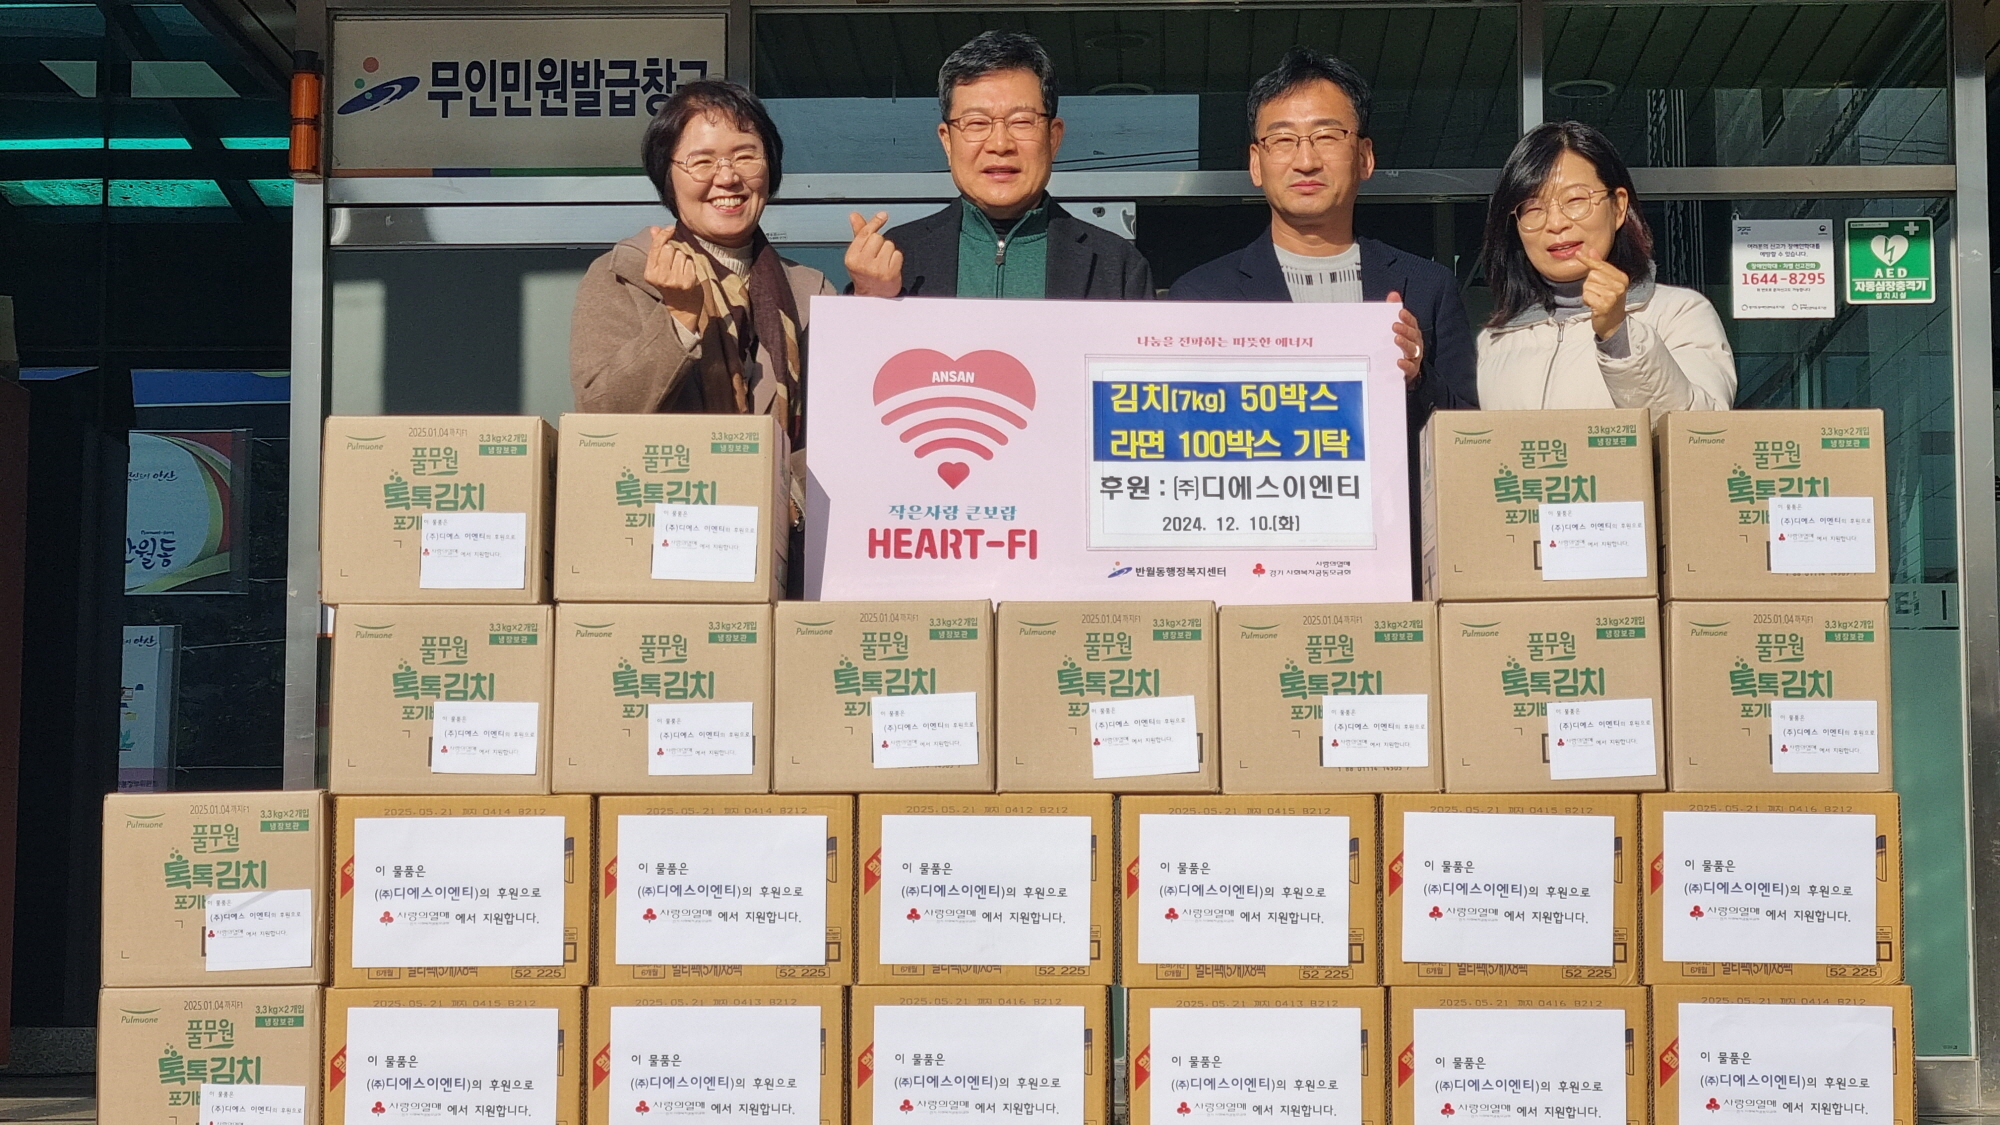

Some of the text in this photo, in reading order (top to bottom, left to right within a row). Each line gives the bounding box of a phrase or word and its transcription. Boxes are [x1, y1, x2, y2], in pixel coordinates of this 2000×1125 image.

[1742, 273, 1825, 285] 1644-8295
[1855, 281, 1926, 291] 자동심장충격기
[1137, 336, 1313, 347] 나눔을 전파하는 따뜻한 에너지
[932, 371, 975, 383] ANSAN
[1241, 383, 1338, 412] 50박스
[347, 443, 383, 451] Pulmuone
[1111, 429, 1350, 459] 라면 100박스 기탁
[1454, 437, 1491, 445] Pulmuone
[642, 444, 690, 473] 풀무원
[1519, 439, 1567, 469] 풀무원
[1753, 441, 1801, 469] 풀무원
[410, 447, 458, 476] 풀무원
[1100, 476, 1150, 500] 후원
[888, 505, 1017, 521] 작은사랑 큰보람
[1162, 517, 1206, 531] 2024.
[1216, 517, 1239, 531] 12.
[868, 528, 1037, 560] HEART-FI
[1136, 567, 1226, 577] 반월동행정복지센터
[356, 631, 392, 639] Pulmuone
[1691, 629, 1728, 637] Pulmuone
[420, 636, 468, 665] 풀무원
[639, 634, 687, 663] 풀무원
[860, 631, 908, 661] 풀무원
[1084, 632, 1132, 661] 풀무원
[1305, 635, 1354, 664] 풀무원
[1527, 632, 1576, 661] 풀무원
[1755, 633, 1804, 663] 풀무원
[191, 824, 239, 853] 풀무원
[376, 865, 426, 878] 이 물품은
[639, 862, 689, 875] 이 물품은
[902, 862, 953, 875] 이 물품은
[1160, 862, 1211, 875] 이 물품은
[1424, 860, 1475, 873] 이 물품은
[1685, 860, 1735, 872] 이 물품은
[497, 888, 541, 900] 후원으로
[760, 886, 803, 898] 후원으로
[1023, 886, 1068, 898] 후원으로
[1282, 886, 1326, 898] 후원으로
[1546, 886, 1590, 898] 후원으로
[1808, 885, 1853, 897] 후원으로
[397, 911, 540, 925] 사랑의열매 에서 지원합니다.
[660, 909, 802, 923] 사랑의열매 에서 지원합니다.
[924, 909, 1066, 924] 사랑의열매 에서 지원합니다.
[1182, 909, 1324, 924] 사랑의열매 에서 지원합니다.
[1446, 907, 1588, 924] 사랑의열매 에서 지원합니다.
[1707, 906, 1851, 923] 사랑의열매 에서 지원합니다.
[515, 969, 561, 978] 52 225
[1302, 970, 1349, 979] 52 225
[121, 1016, 158, 1024] Pulmuone
[186, 1019, 234, 1049] 풀무원
[367, 1055, 418, 1068] 이 물품은
[1172, 1056, 1222, 1068] 이 물품은
[489, 1080, 534, 1091] 후원으로
[1294, 1080, 1338, 1091] 후원으로
[389, 1102, 531, 1117] 사랑의열매 에서 지원합니다.
[1194, 1103, 1337, 1117] 사랑의열매 에서 지원합니다.
